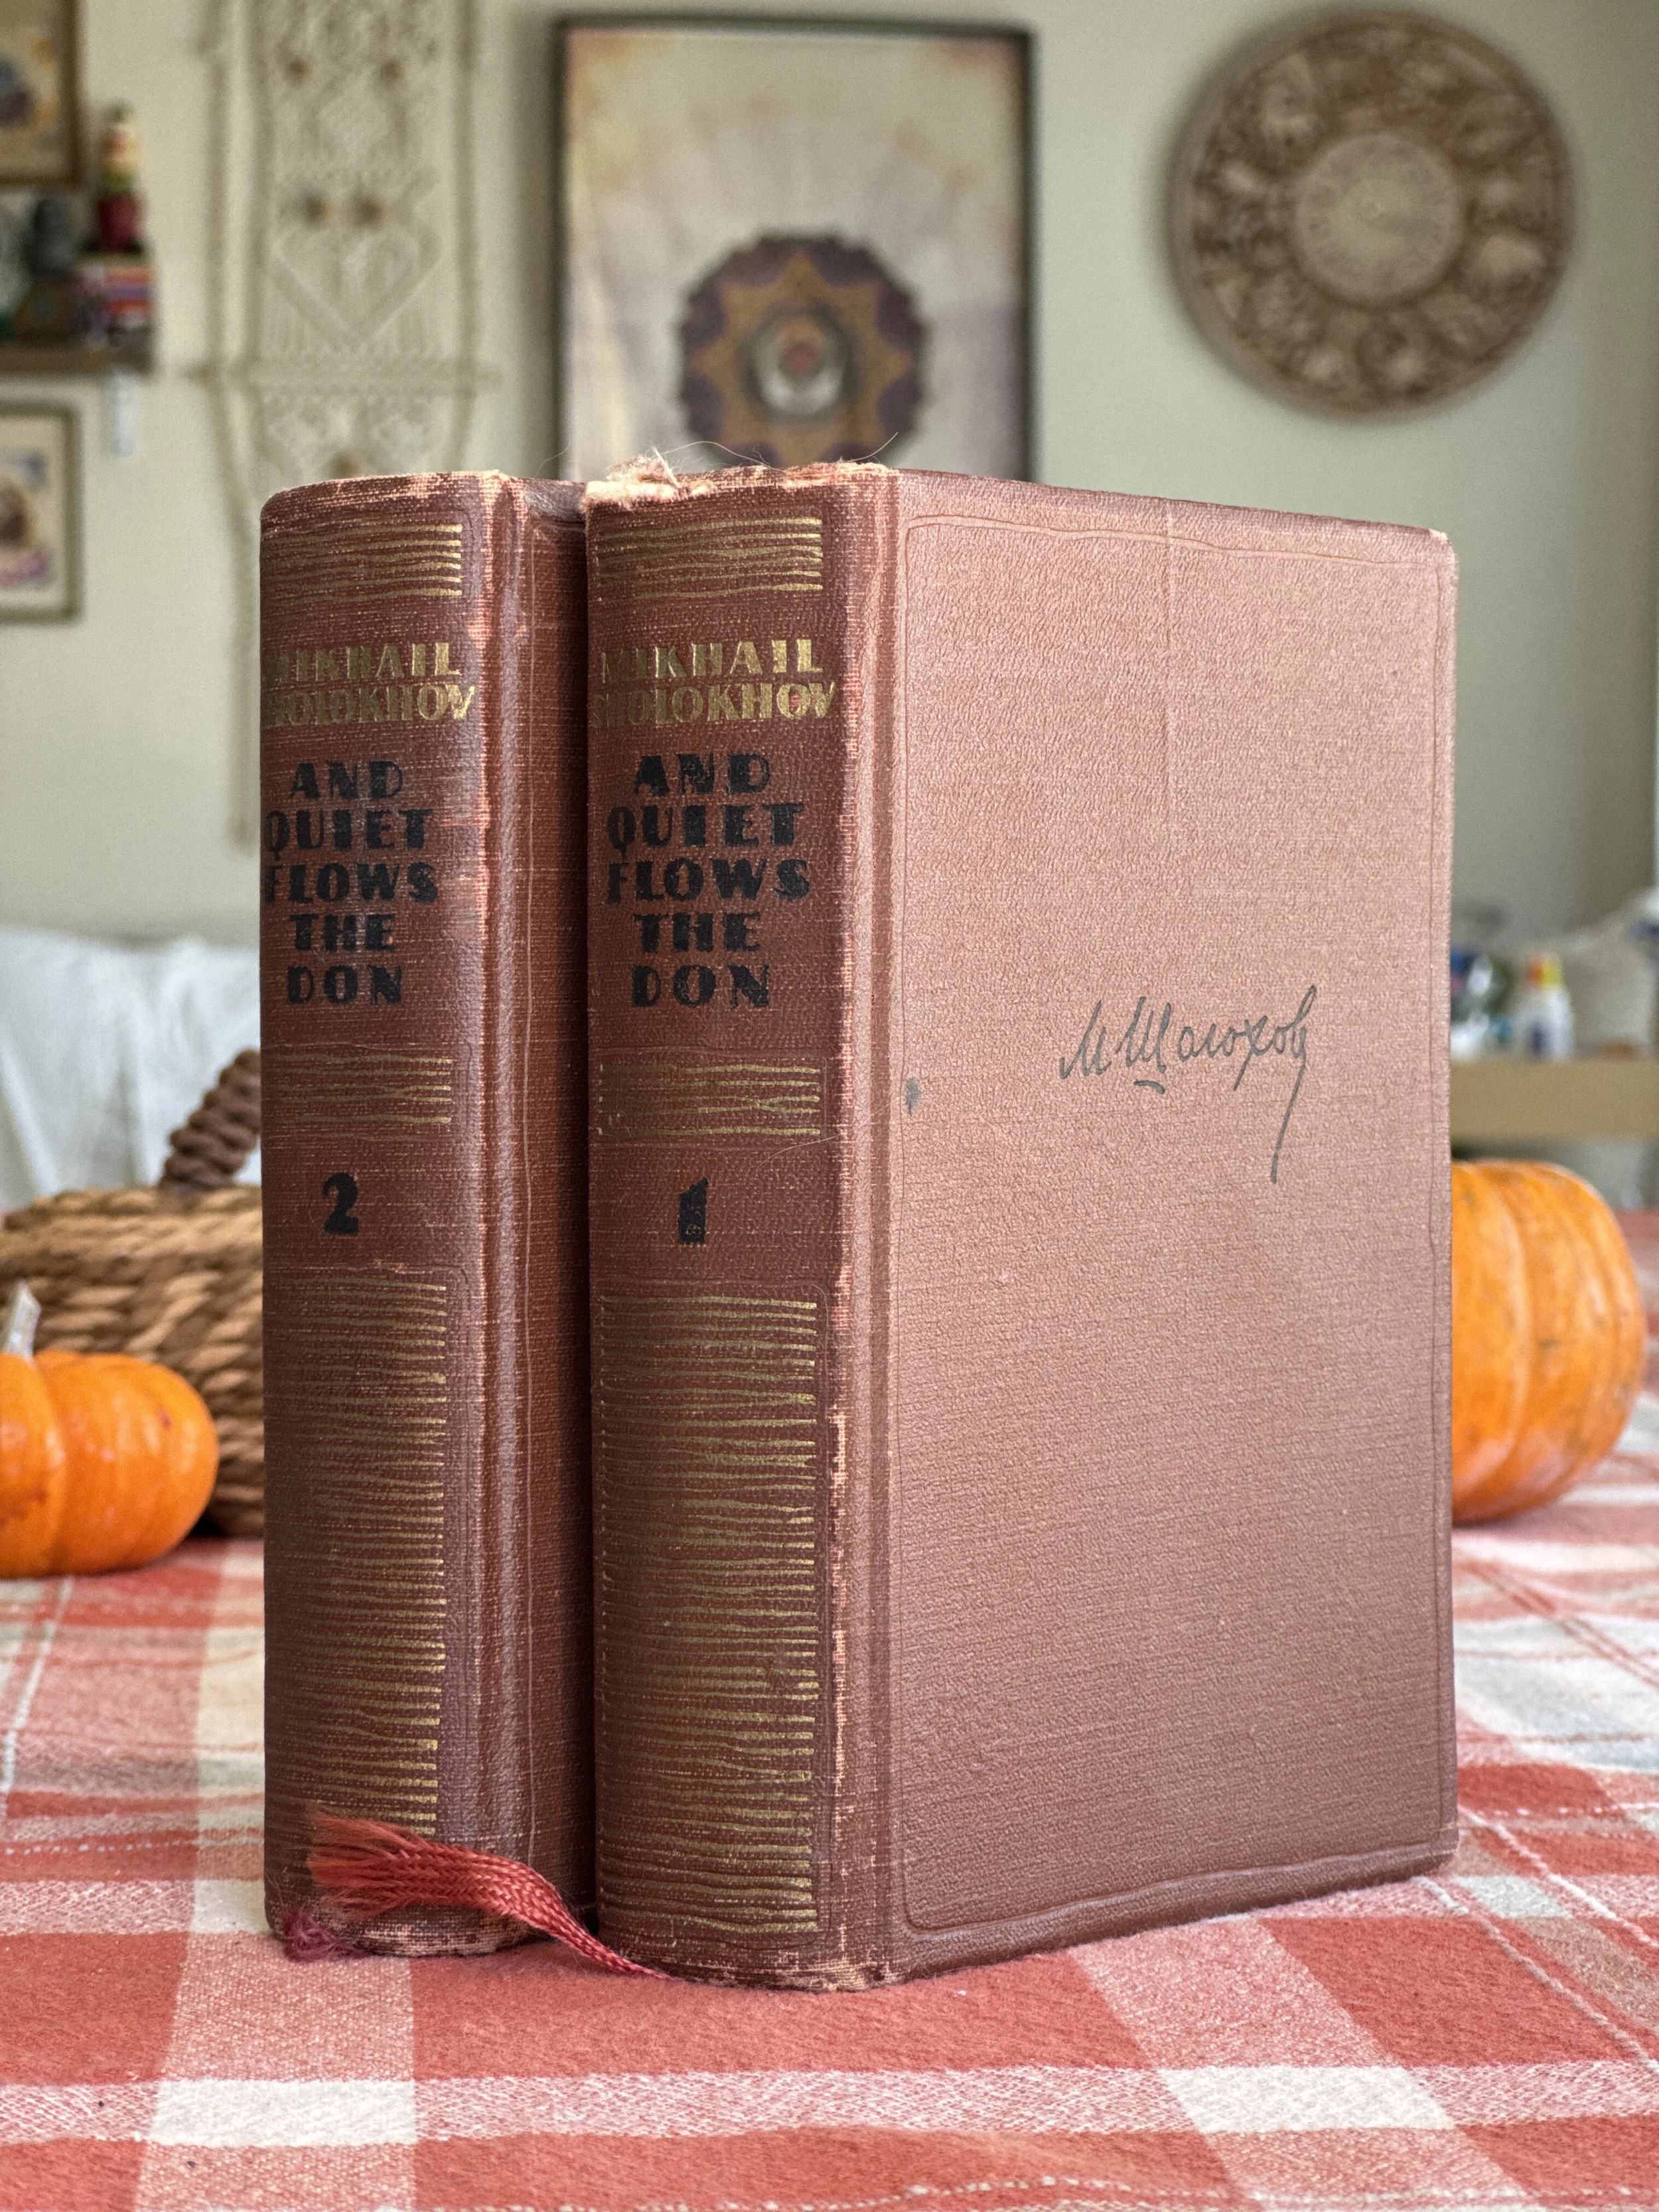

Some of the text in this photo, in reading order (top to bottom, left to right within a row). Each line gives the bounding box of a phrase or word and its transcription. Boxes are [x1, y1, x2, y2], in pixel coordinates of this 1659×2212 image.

[261, 642, 462, 683] IKHAIL
[261, 684, 476, 727] OLOKHOV
[290, 760, 403, 799] AND
[634, 753, 770, 796] AND
[263, 808, 433, 861] QUIET
[607, 802, 804, 861] QUIET
[263, 862, 439, 903] FLOWS
[607, 857, 810, 904] FLOWS
[289, 913, 396, 952] THE
[632, 911, 761, 953] THE
[286, 964, 403, 1005] DON
[631, 964, 769, 1008] DON
[323, 1172, 359, 1236] 2
[678, 1177, 709, 1244] 1
